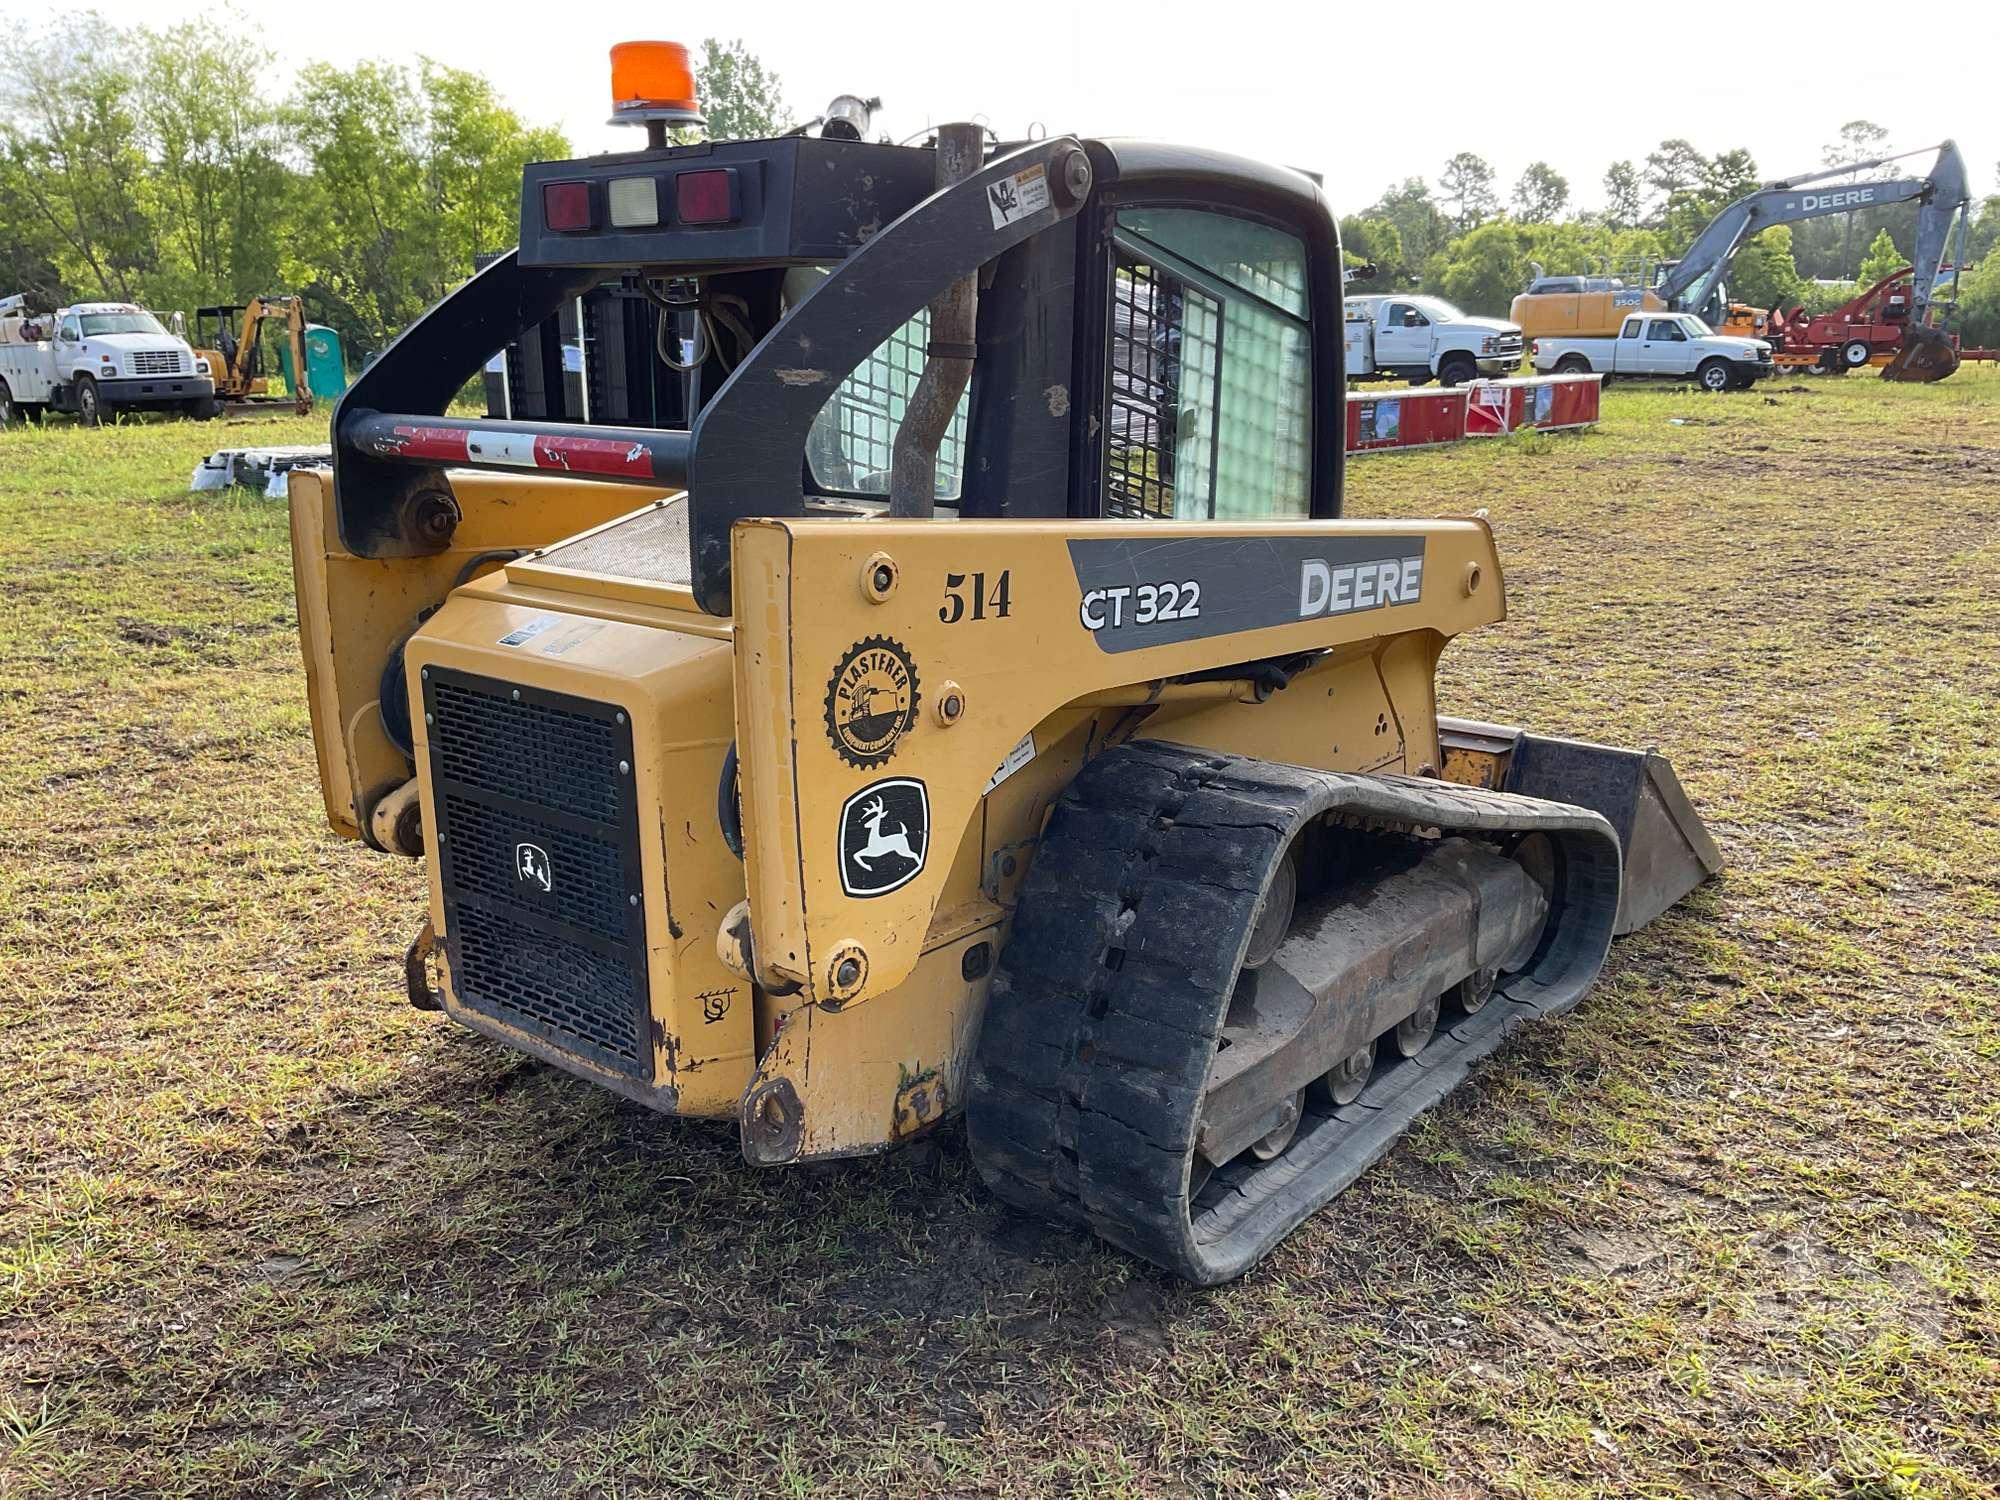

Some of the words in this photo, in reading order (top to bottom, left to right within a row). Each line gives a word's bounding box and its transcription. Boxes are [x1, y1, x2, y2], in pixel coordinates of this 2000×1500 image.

[1802, 188, 1875, 211] DEERE
[938, 569, 1012, 624] 514
[1080, 588, 1131, 630] CT
[1136, 579, 1201, 623] 322
[1299, 559, 1423, 617] DEERE
[838, 652, 908, 699] PLASTERER
